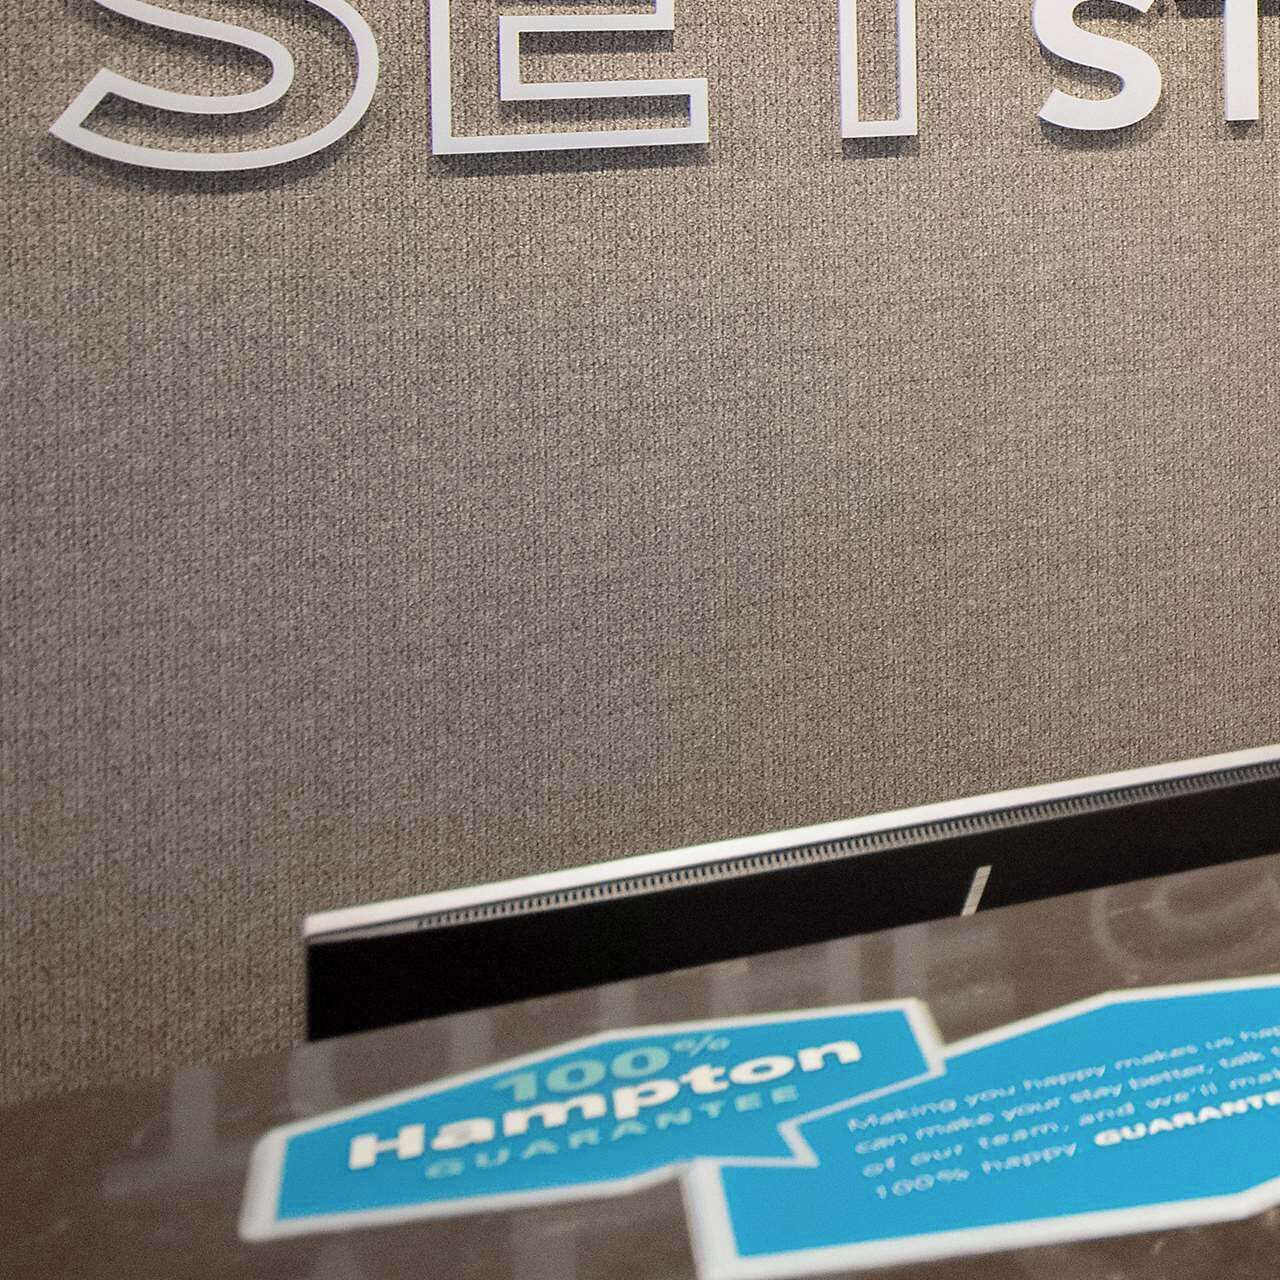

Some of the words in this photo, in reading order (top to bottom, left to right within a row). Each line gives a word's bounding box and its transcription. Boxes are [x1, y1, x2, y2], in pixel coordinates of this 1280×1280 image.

[347, 1039, 862, 1171] Hampton
[492, 1033, 730, 1104] 100%
[848, 1098, 958, 1132] Making
[964, 1085, 1016, 1108] you
[1023, 1064, 1106, 1091] happy
[1115, 1044, 1198, 1071] makes
[1205, 1036, 1234, 1051] us
[854, 1132, 908, 1155] can
[915, 1112, 995, 1140] make
[1001, 1096, 1061, 1122] your
[1069, 1082, 1123, 1104] stay
[1219, 1050, 1265, 1070] talk
[424, 1084, 801, 1181] GUARANTEE
[861, 1155, 895, 1178] of
[910, 1143, 963, 1167] our
[1079, 1101, 1136, 1127] and
[876, 1168, 970, 1200] 100%
